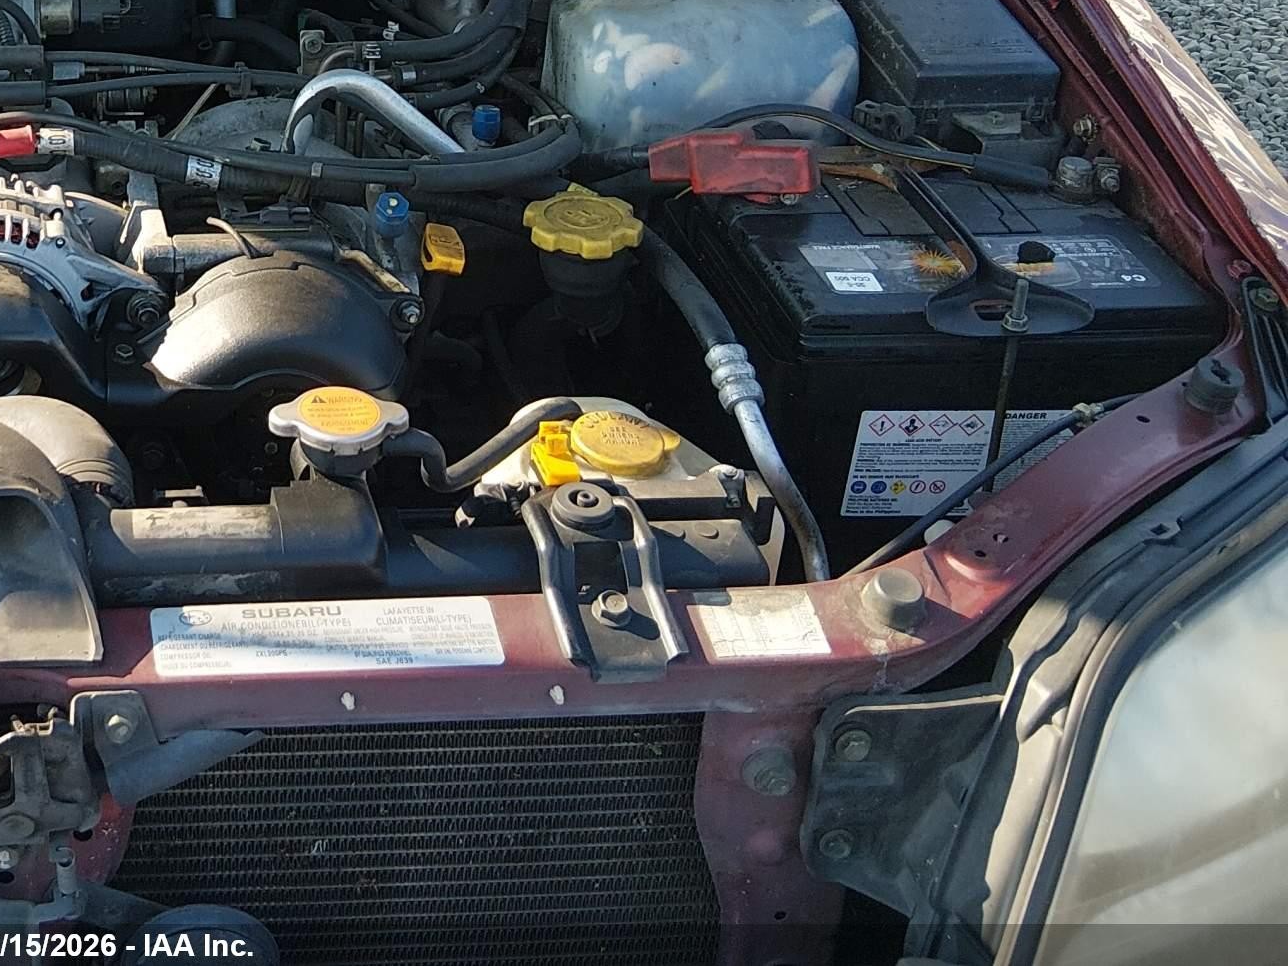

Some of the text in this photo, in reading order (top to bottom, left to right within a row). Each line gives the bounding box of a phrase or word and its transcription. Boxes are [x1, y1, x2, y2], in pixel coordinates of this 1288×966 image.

[1005, 412, 1048, 420] DANGER
[241, 605, 343, 619] SUBARU
[221, 623, 237, 633] AIR
